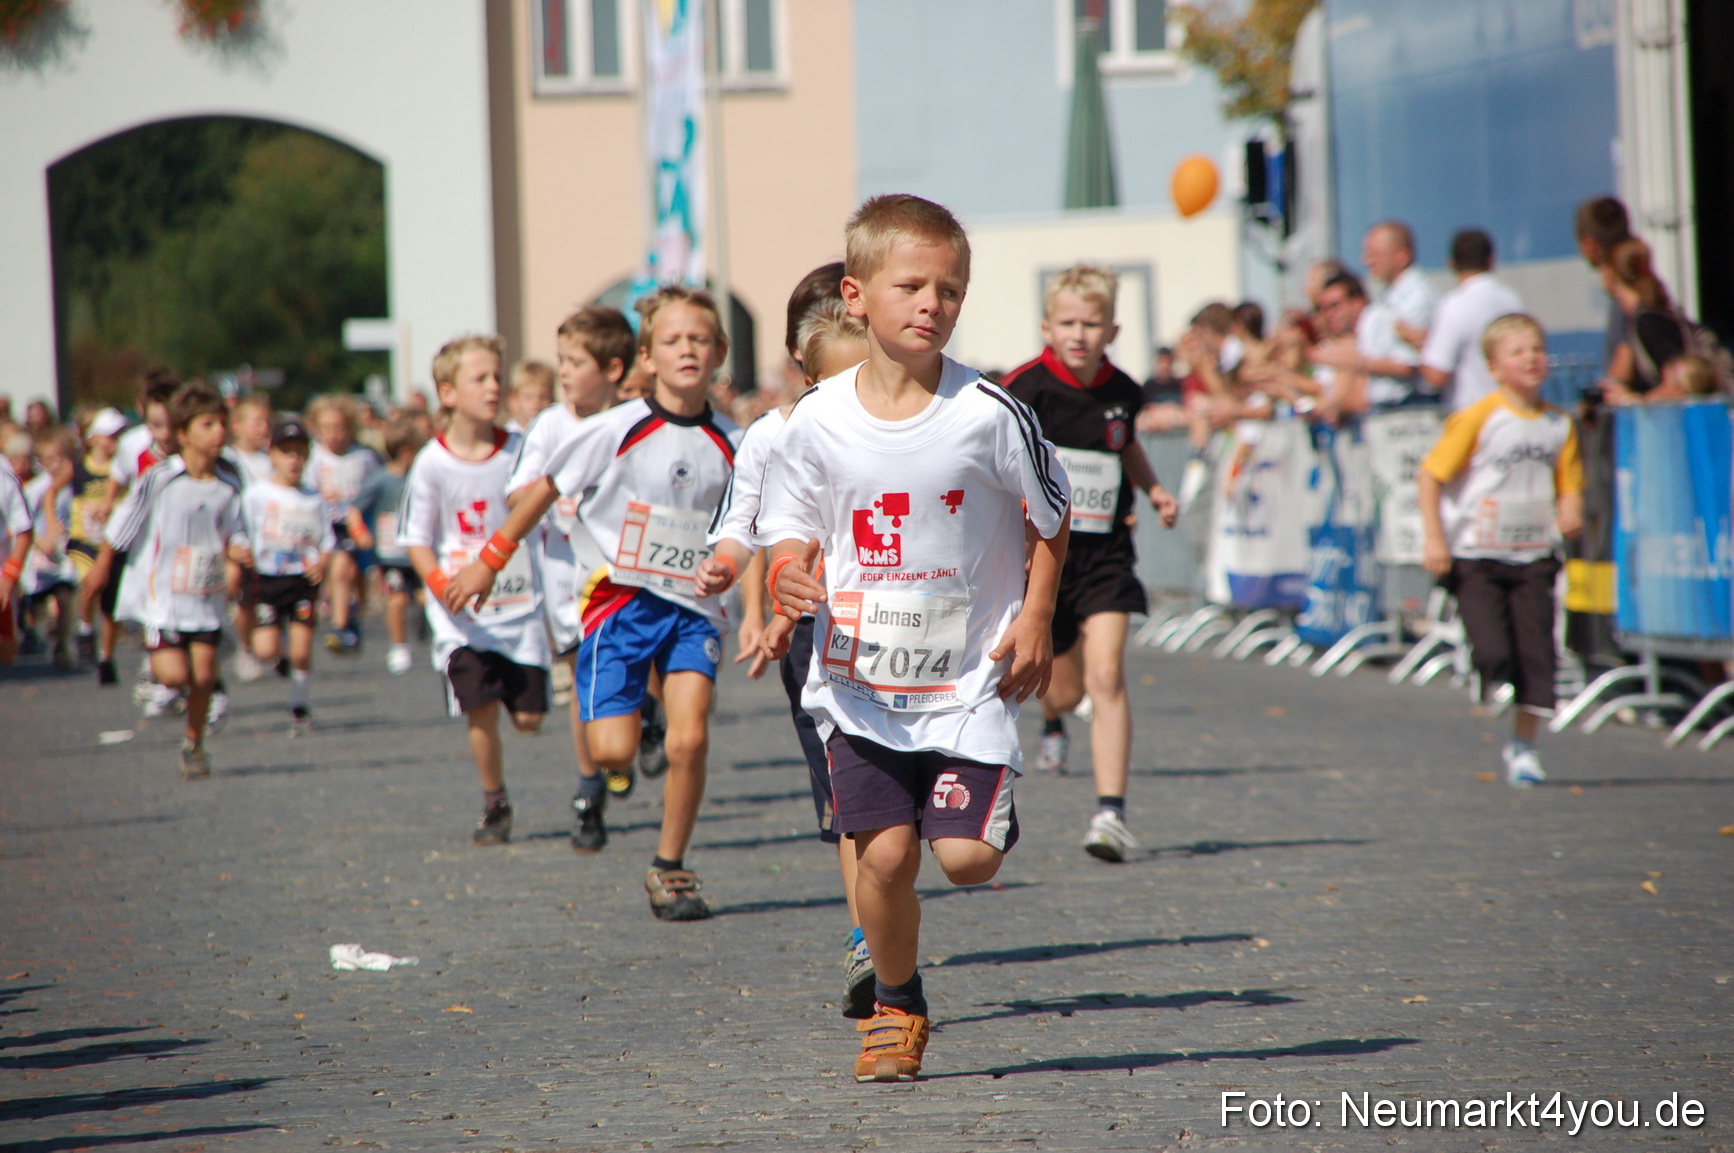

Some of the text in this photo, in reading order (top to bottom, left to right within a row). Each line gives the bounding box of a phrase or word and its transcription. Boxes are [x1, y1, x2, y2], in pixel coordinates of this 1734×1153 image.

[860, 567, 958, 582] JEDER EINZELNE ZÄHLT
[867, 602, 922, 628] Jonas
[831, 633, 850, 650] K2
[868, 645, 952, 679] 7074
[909, 692, 957, 704] PFLEIDERER
